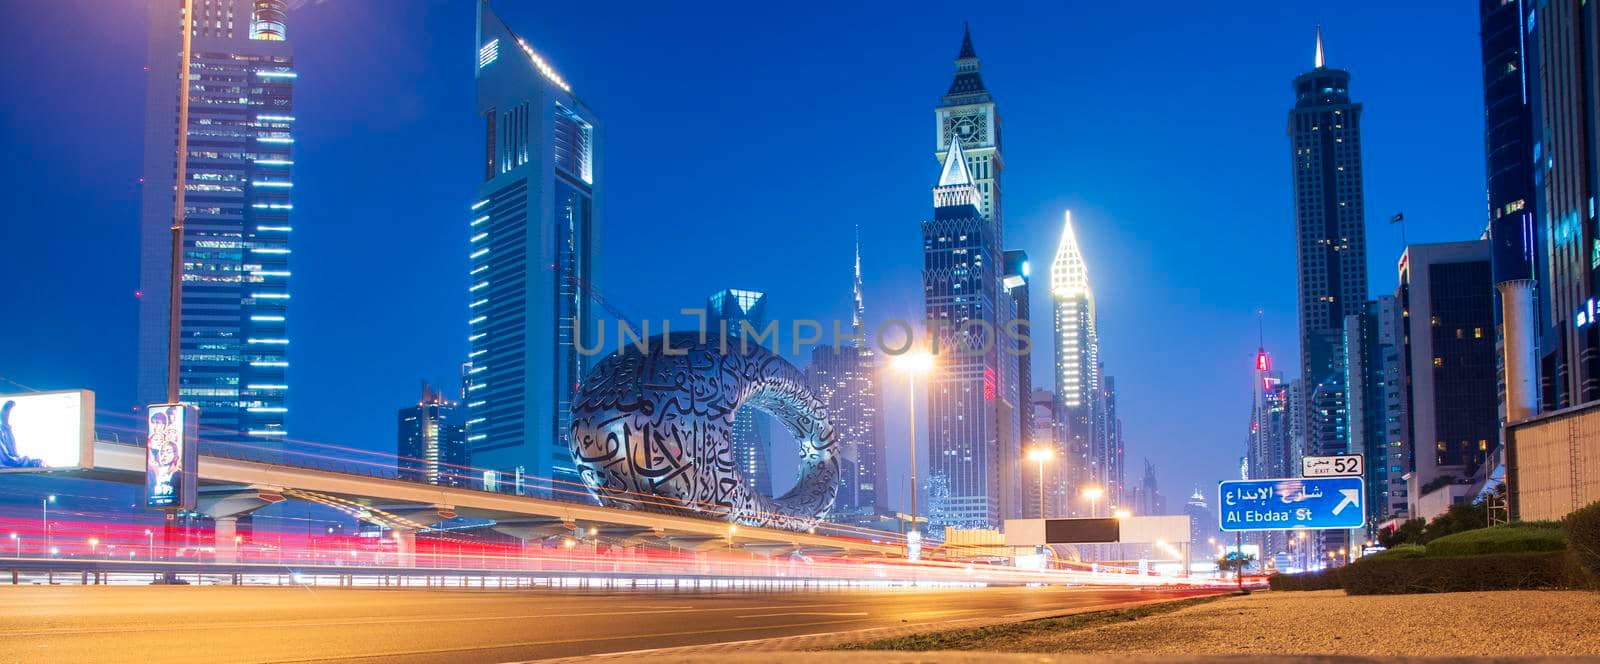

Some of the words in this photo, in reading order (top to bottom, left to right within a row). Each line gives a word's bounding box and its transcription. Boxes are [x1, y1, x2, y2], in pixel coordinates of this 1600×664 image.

[1306, 459, 1330, 468] مخرج
[1334, 457, 1358, 473] 52
[1225, 486, 1273, 506] الإبداع
[1280, 485, 1323, 503] شارع
[1226, 510, 1241, 523] Al
[1295, 508, 1313, 521] St
